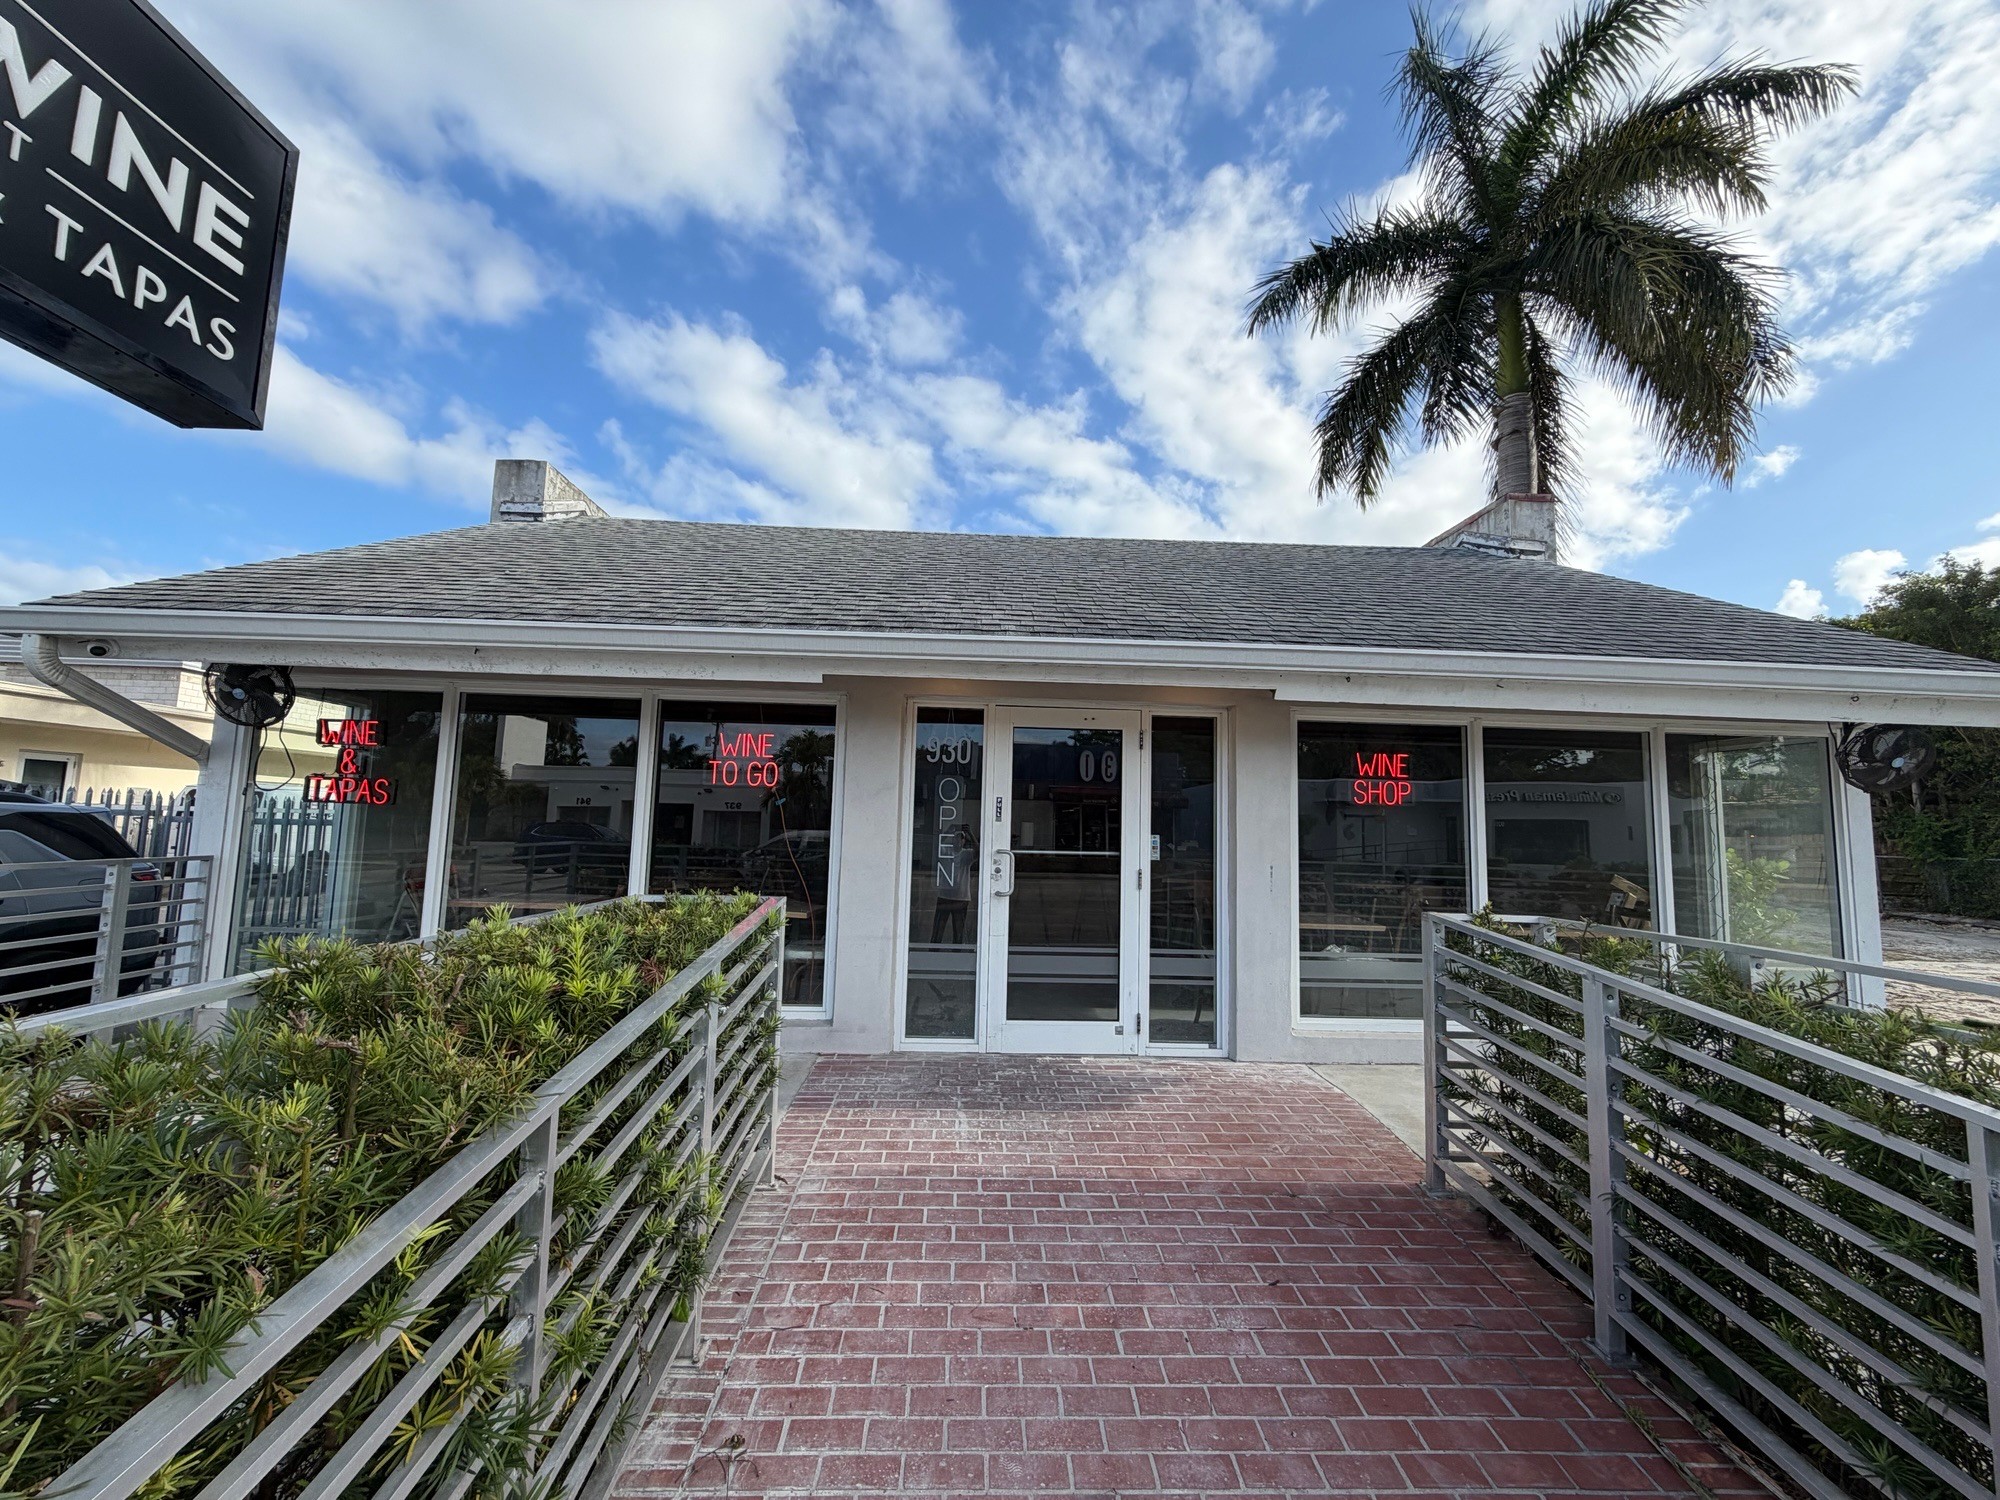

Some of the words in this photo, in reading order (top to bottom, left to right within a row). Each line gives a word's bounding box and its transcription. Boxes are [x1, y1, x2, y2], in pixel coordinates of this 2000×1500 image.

[45, 203, 237, 361] TAPAS
[321, 719, 379, 746] WINE
[719, 732, 775, 758] WINE
[340, 748, 357, 774] &
[926, 736, 972, 765] 930
[708, 760, 738, 786] TO
[747, 761, 778, 787] GO
[1356, 752, 1409, 778] WINE
[308, 777, 389, 805] TAPAS
[1353, 779, 1411, 806] SHOP
[936, 777, 960, 887] OPEN
